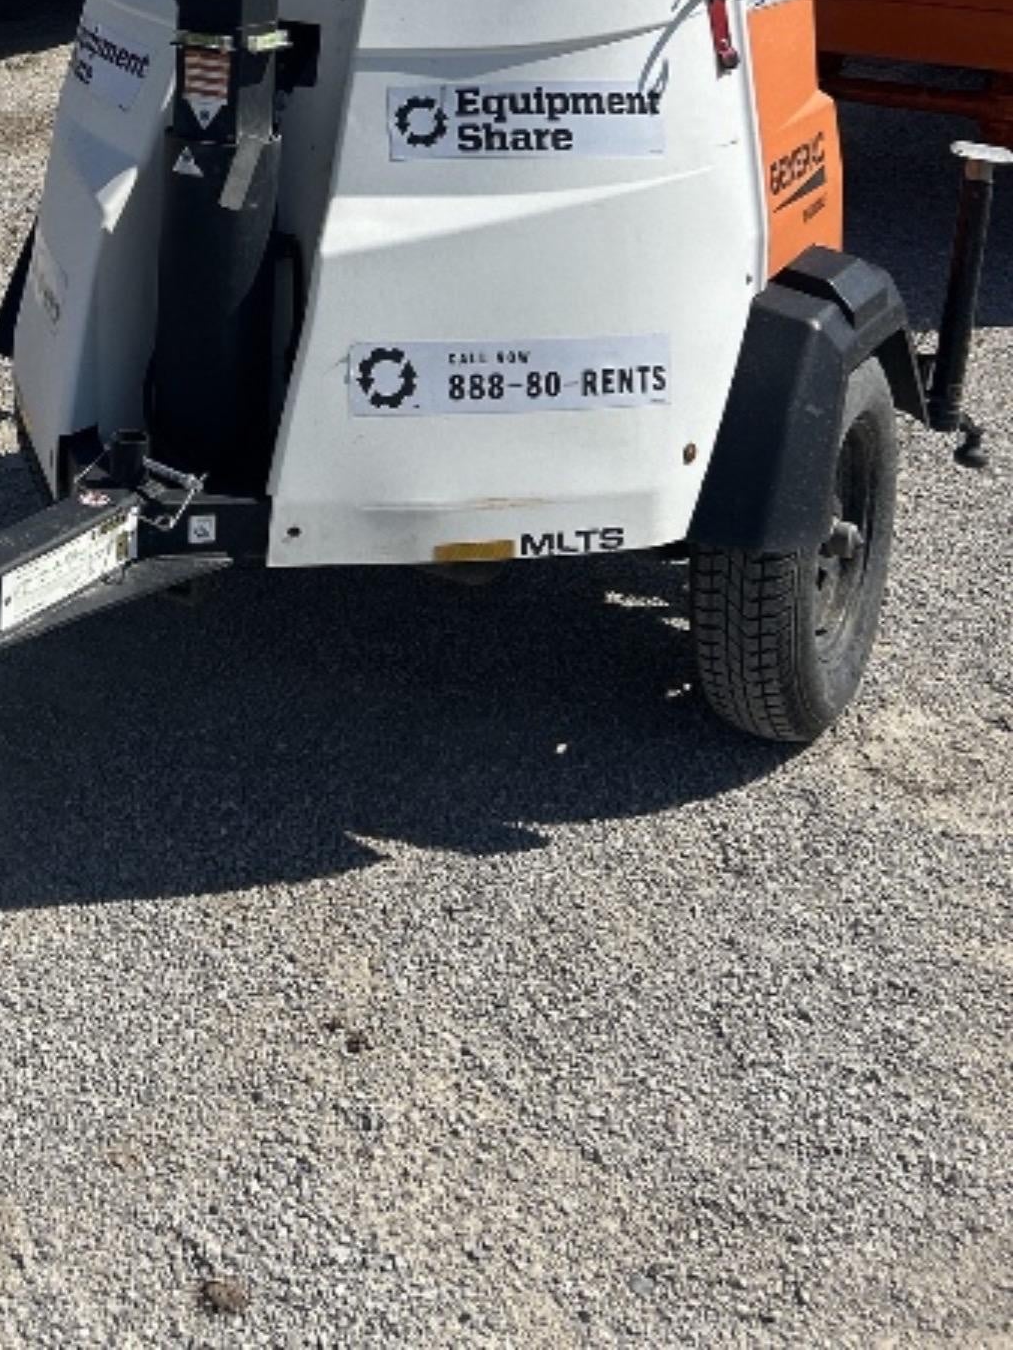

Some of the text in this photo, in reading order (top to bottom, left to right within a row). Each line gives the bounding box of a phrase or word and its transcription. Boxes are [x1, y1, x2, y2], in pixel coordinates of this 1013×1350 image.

[454, 86, 662, 123] Equipment
[456, 122, 574, 152] Share
[520, 527, 625, 557] MLTS
